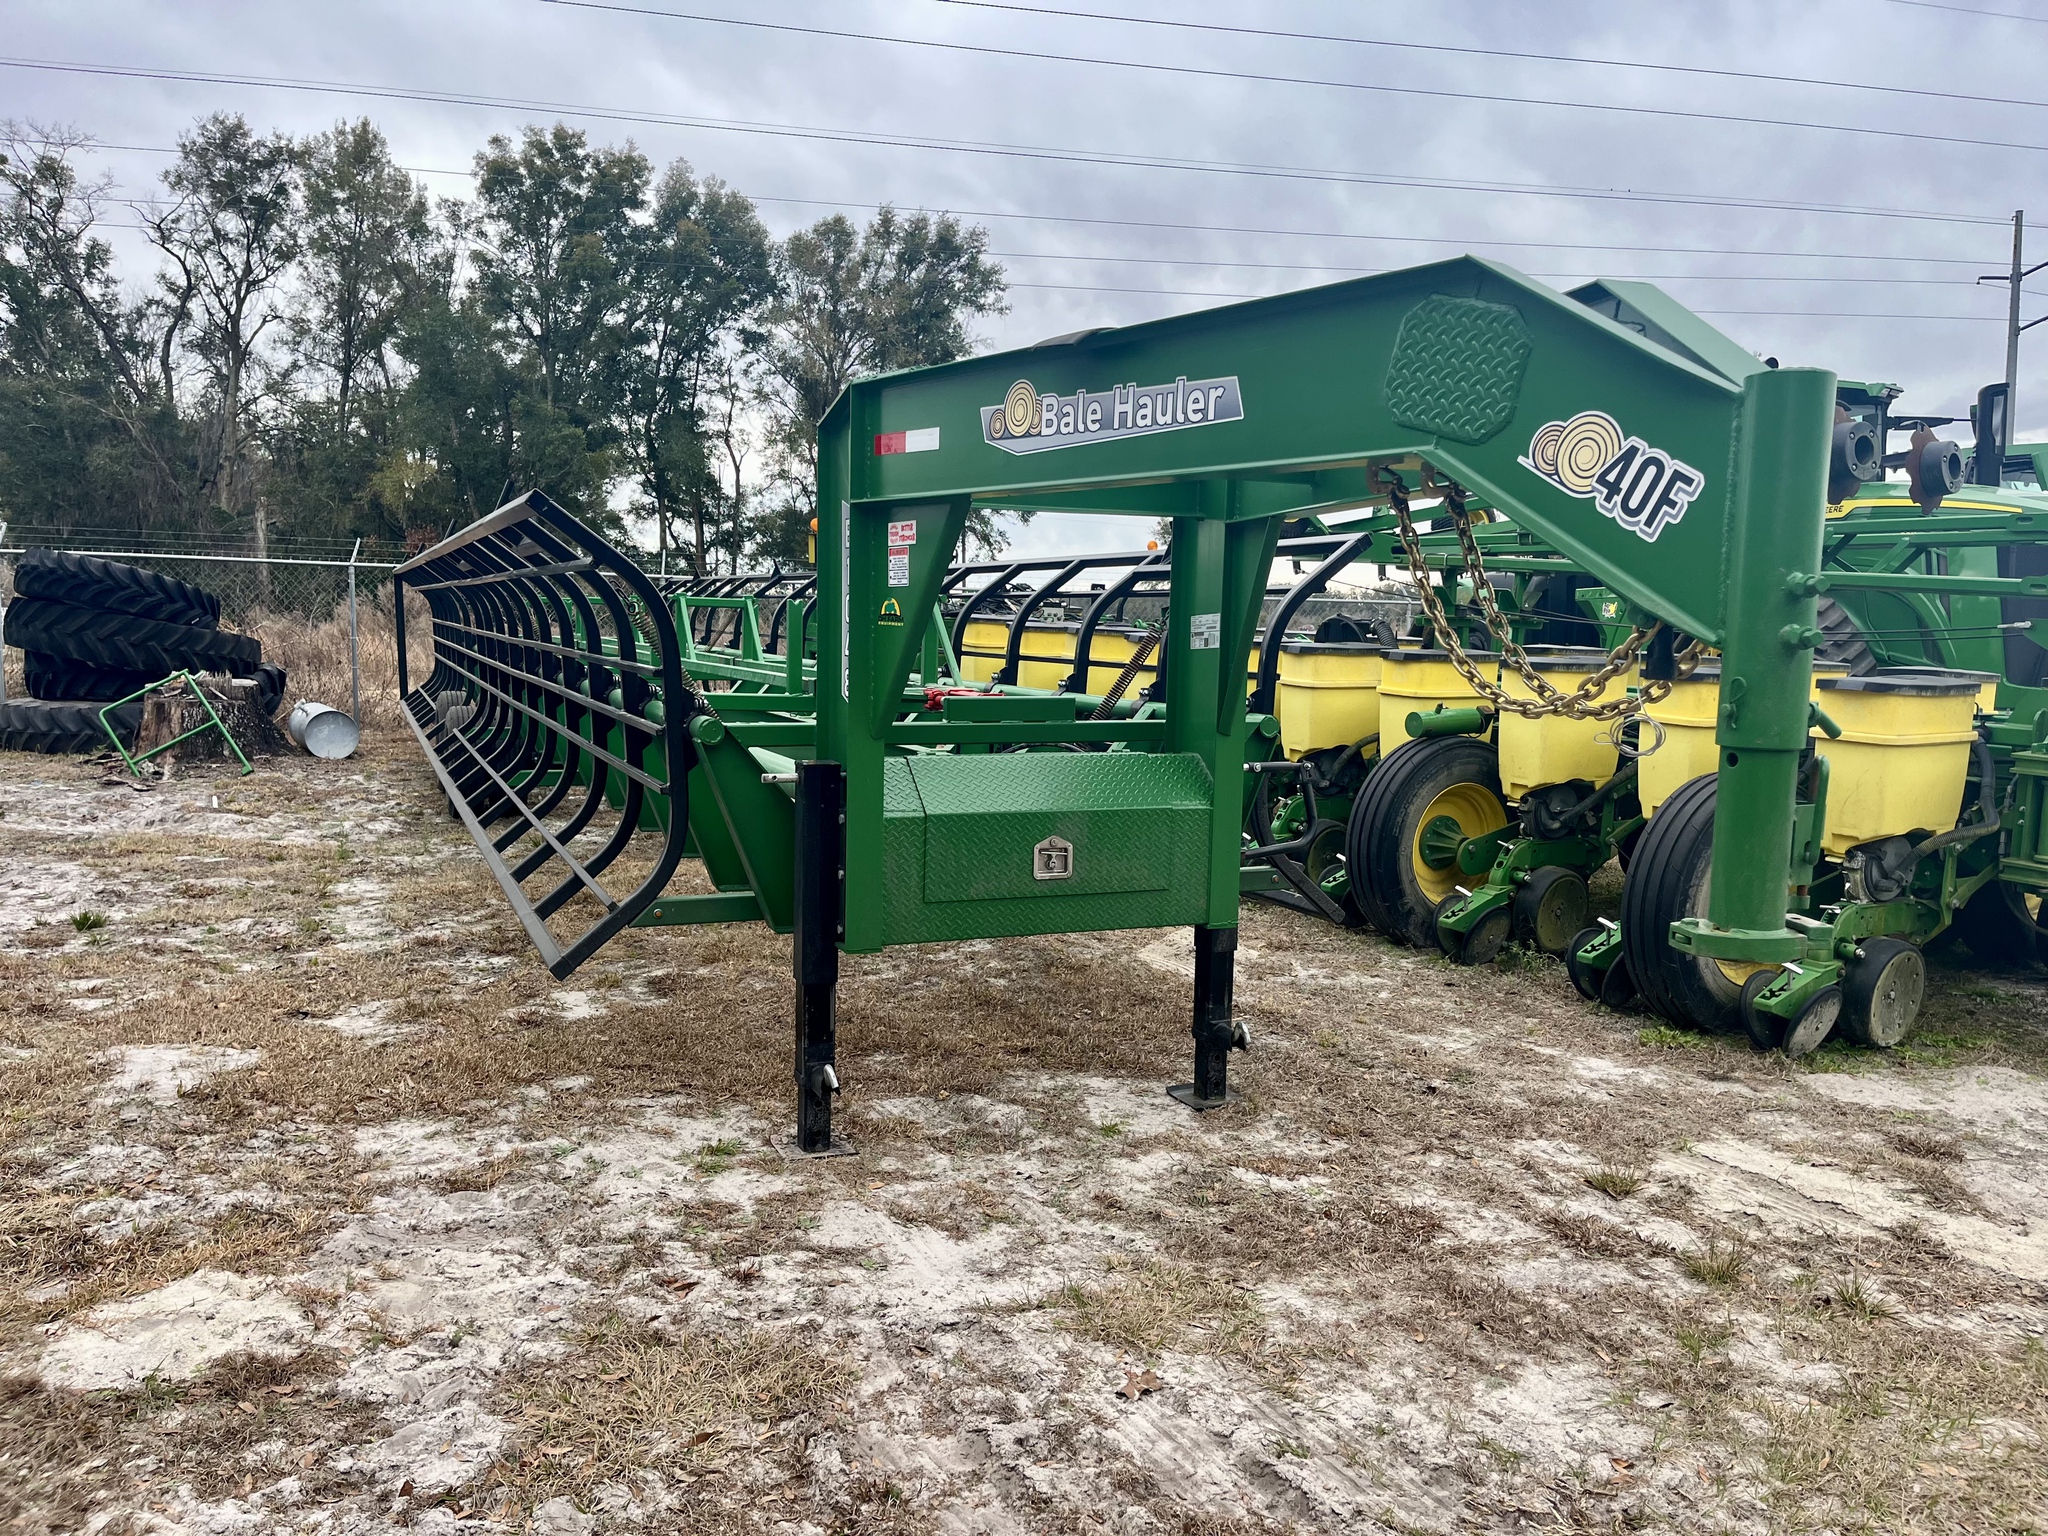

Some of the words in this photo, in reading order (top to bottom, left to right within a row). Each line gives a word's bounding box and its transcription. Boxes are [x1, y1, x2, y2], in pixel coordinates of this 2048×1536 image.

[1040, 390, 1102, 437] Bale
[1113, 378, 1226, 430] Hauler
[1593, 440, 1700, 536] 40F
